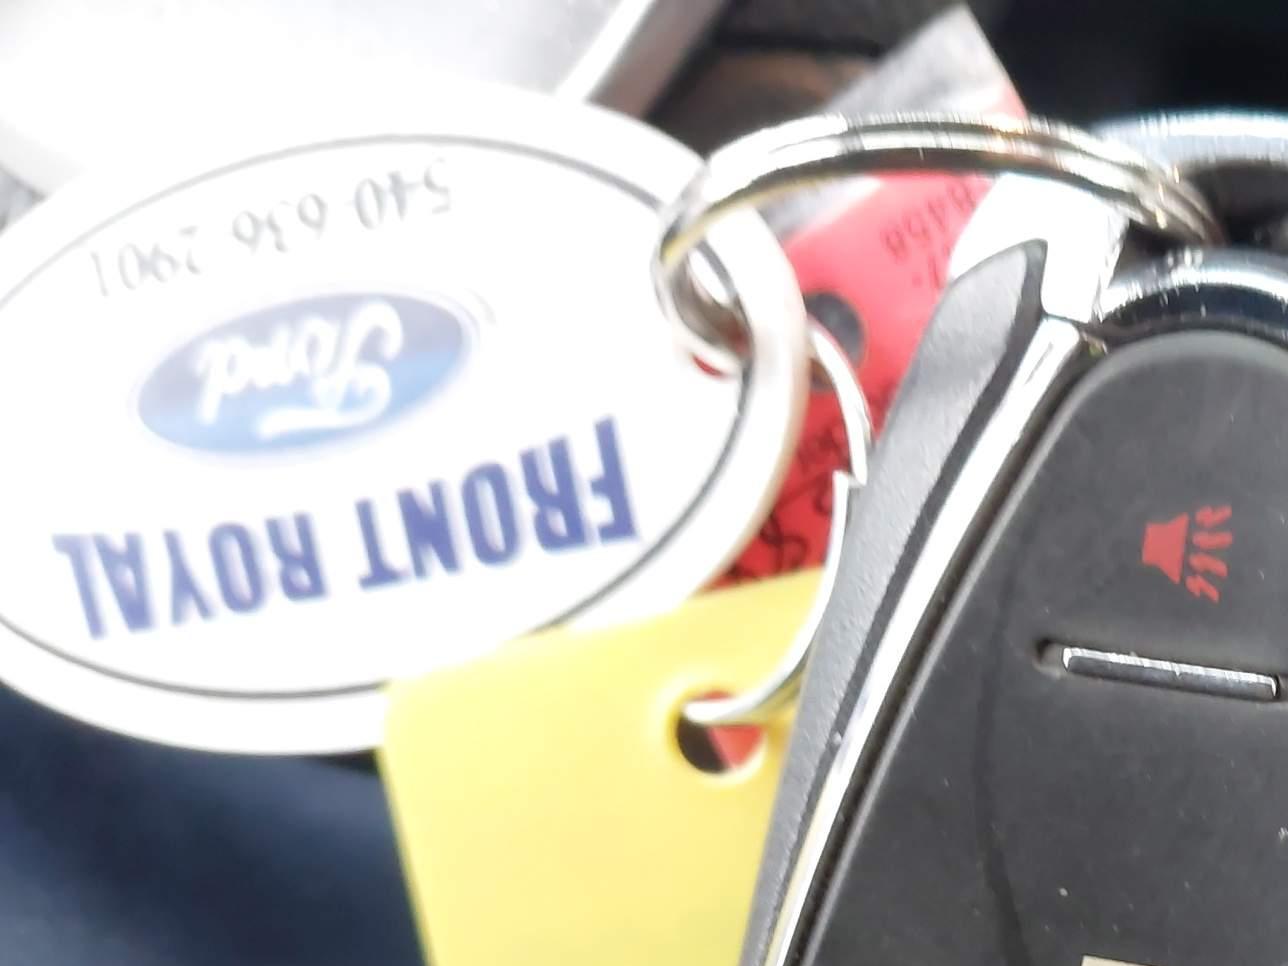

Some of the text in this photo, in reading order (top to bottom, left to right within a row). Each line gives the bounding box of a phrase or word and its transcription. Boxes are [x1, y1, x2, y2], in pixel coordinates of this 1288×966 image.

[90, 156, 452, 297] 540 636 2901
[194, 299, 404, 441] Ford
[355, 415, 638, 590] FRONT
[51, 511, 329, 640] ROYAL
